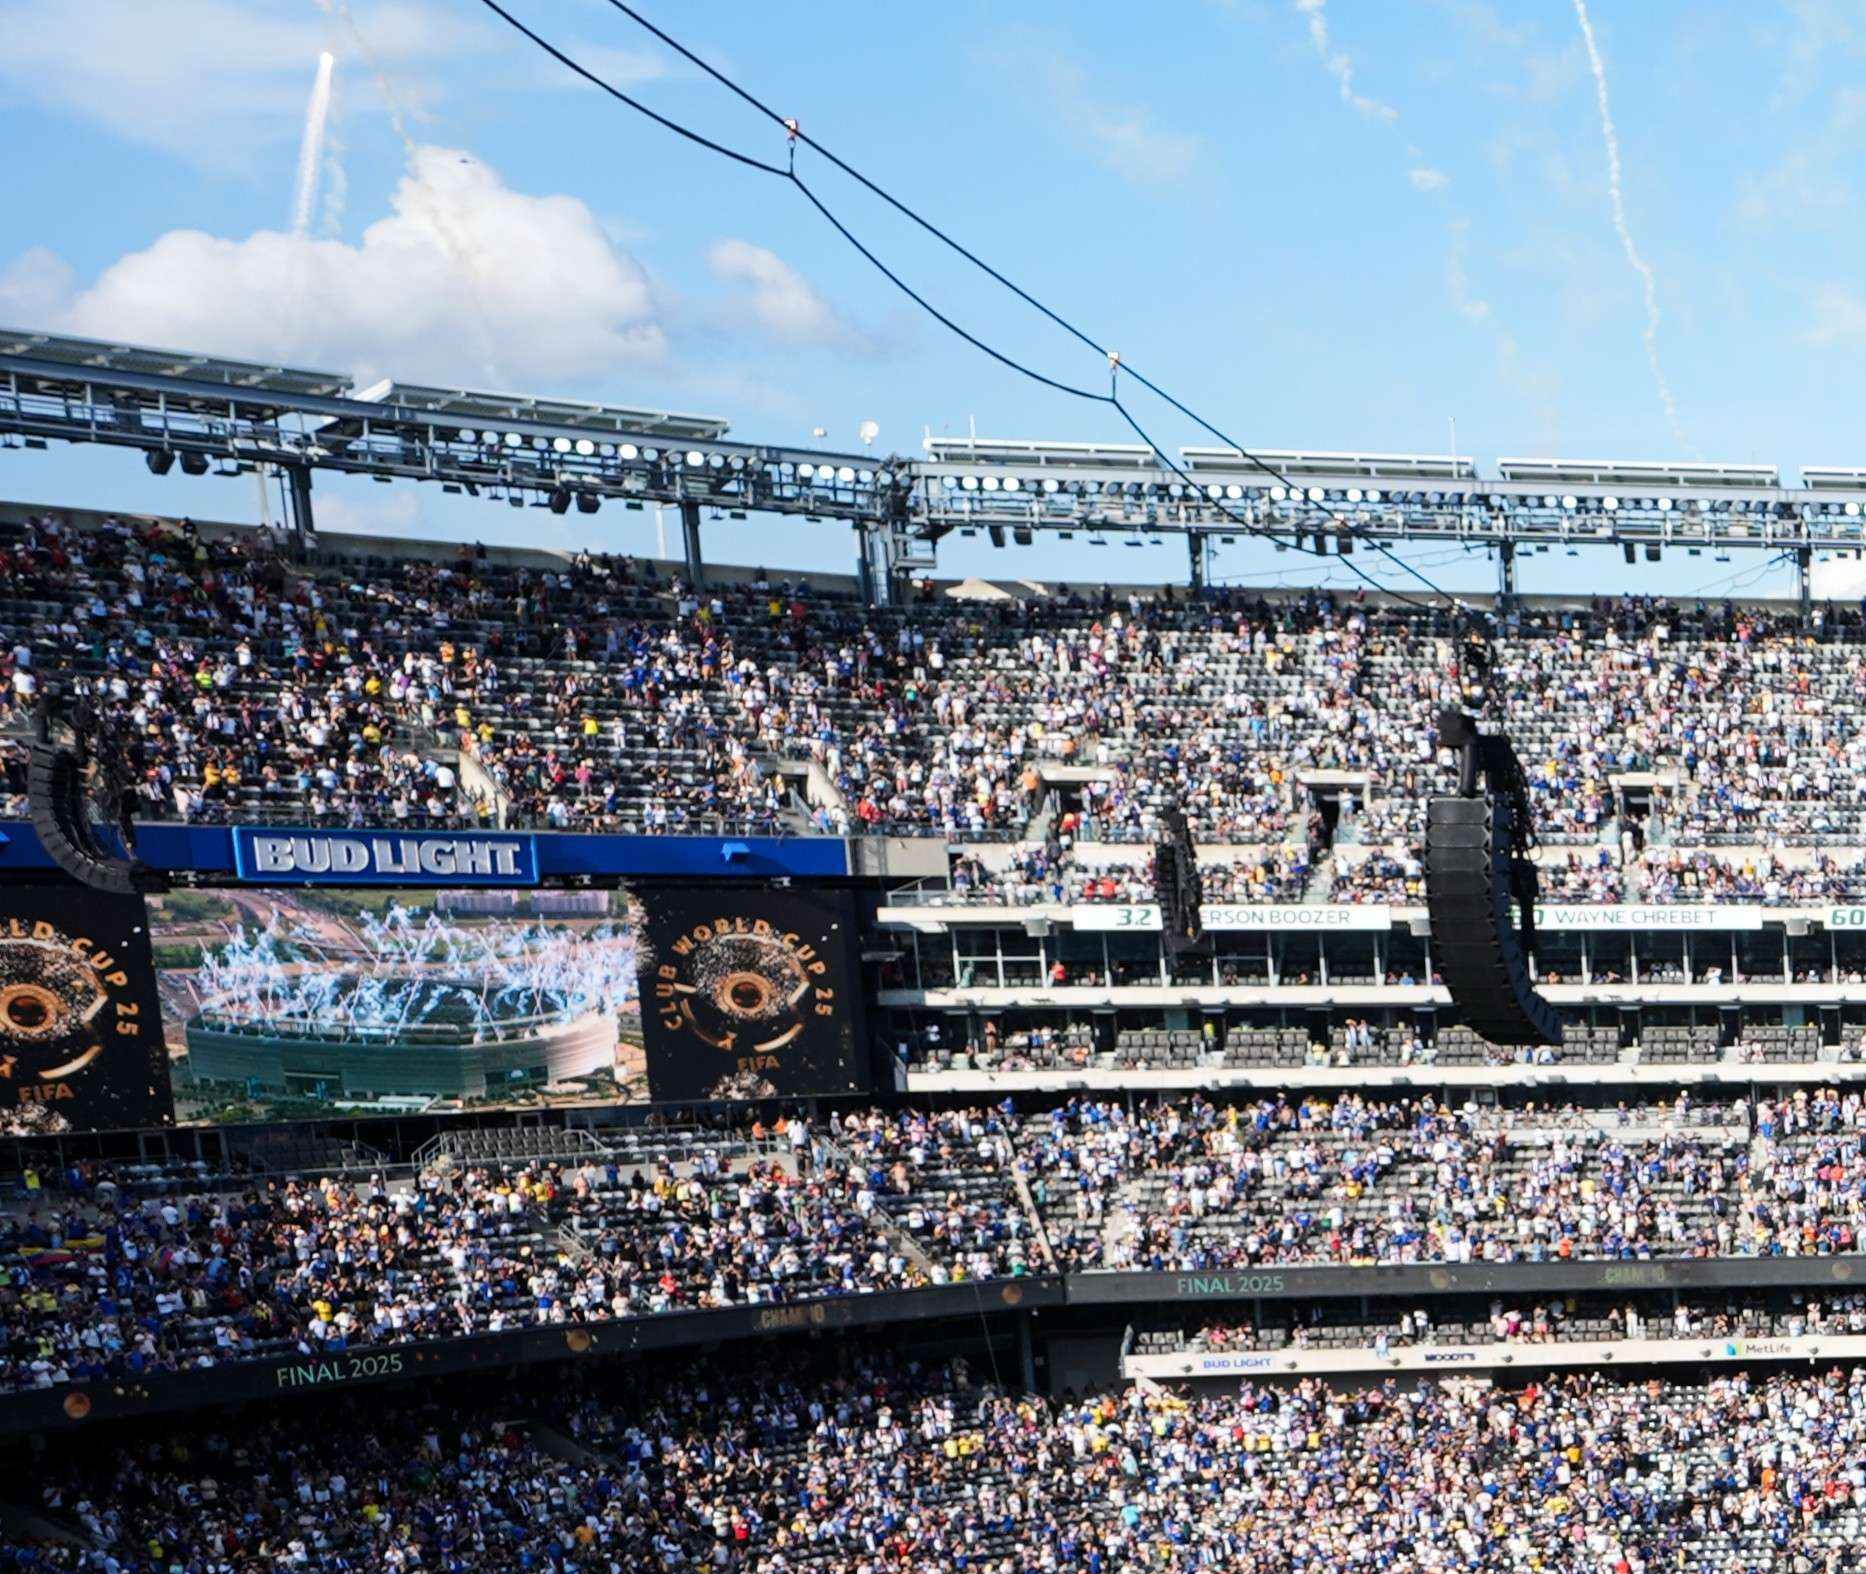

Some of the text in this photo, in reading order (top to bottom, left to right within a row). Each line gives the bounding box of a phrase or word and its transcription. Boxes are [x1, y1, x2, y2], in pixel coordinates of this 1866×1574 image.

[253, 836, 521, 874] BUD LIGHT
[1270, 910, 1350, 925] BOOZER
[1554, 910, 1625, 924] WAYNE
[1632, 910, 1716, 924] CHREBET
[1830, 909, 1866, 927] 60
[656, 917, 835, 1030] CLUB WORLD CUP 25
[71, 937, 139, 1036] CUP 25
[737, 1055, 781, 1073] FIFA
[18, 1082, 75, 1102] FIFA
[1177, 1276, 1285, 1294] FINAL 2025
[1745, 1342, 1792, 1355] MetLife
[276, 1352, 404, 1388] FINAL 2025
[1203, 1356, 1273, 1370] BUD LIGHT
